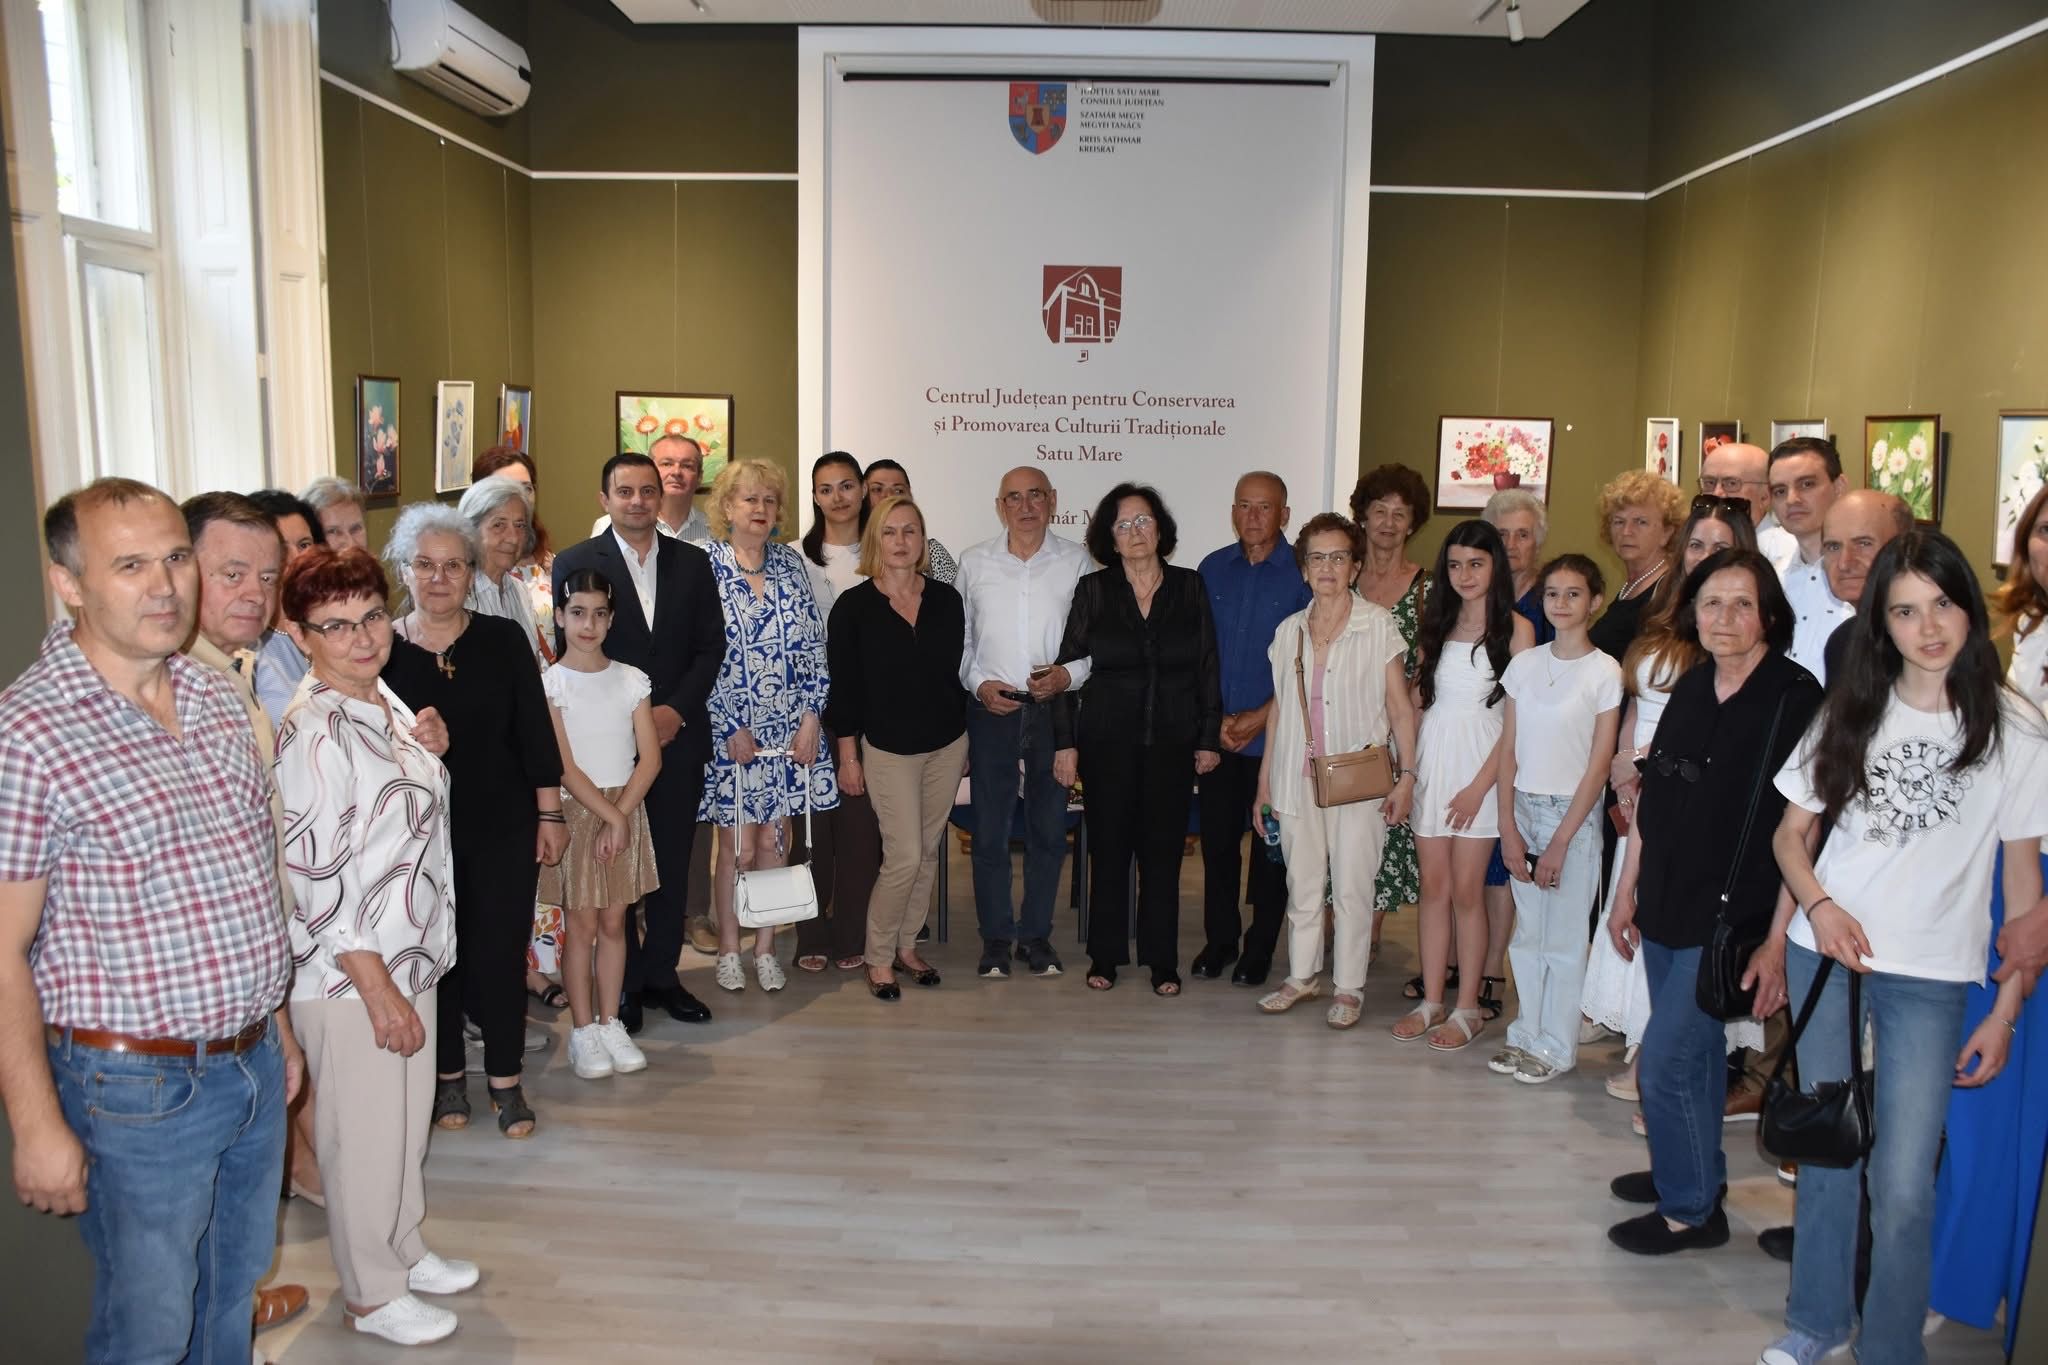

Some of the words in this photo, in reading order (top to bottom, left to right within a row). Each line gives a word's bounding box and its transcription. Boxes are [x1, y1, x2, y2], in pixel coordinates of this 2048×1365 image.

[1117, 88, 1137, 97] SATU
[1139, 89, 1160, 97] MARE
[1080, 97, 1122, 105] CONSILIUL
[1119, 111, 1144, 120] MEGYE
[1080, 121, 1110, 129] MEGYEI
[1079, 135, 1101, 143] KREIS
[1103, 136, 1142, 145] SATHMAR
[1079, 145, 1115, 153] KREISRAT
[926, 387, 990, 404] Centrul
[993, 388, 1067, 409] Județean
[1072, 393, 1127, 411] pentru
[1132, 390, 1235, 408] Conservarea
[934, 416, 946, 436] și
[951, 415, 1050, 433] Promovarea
[1055, 417, 1121, 433] Culturii
[1124, 417, 1226, 440] Tradiționale
[1036, 444, 1073, 461] Satu
[1078, 445, 1123, 462] Mare
[1047, 510, 1078, 525] nár
